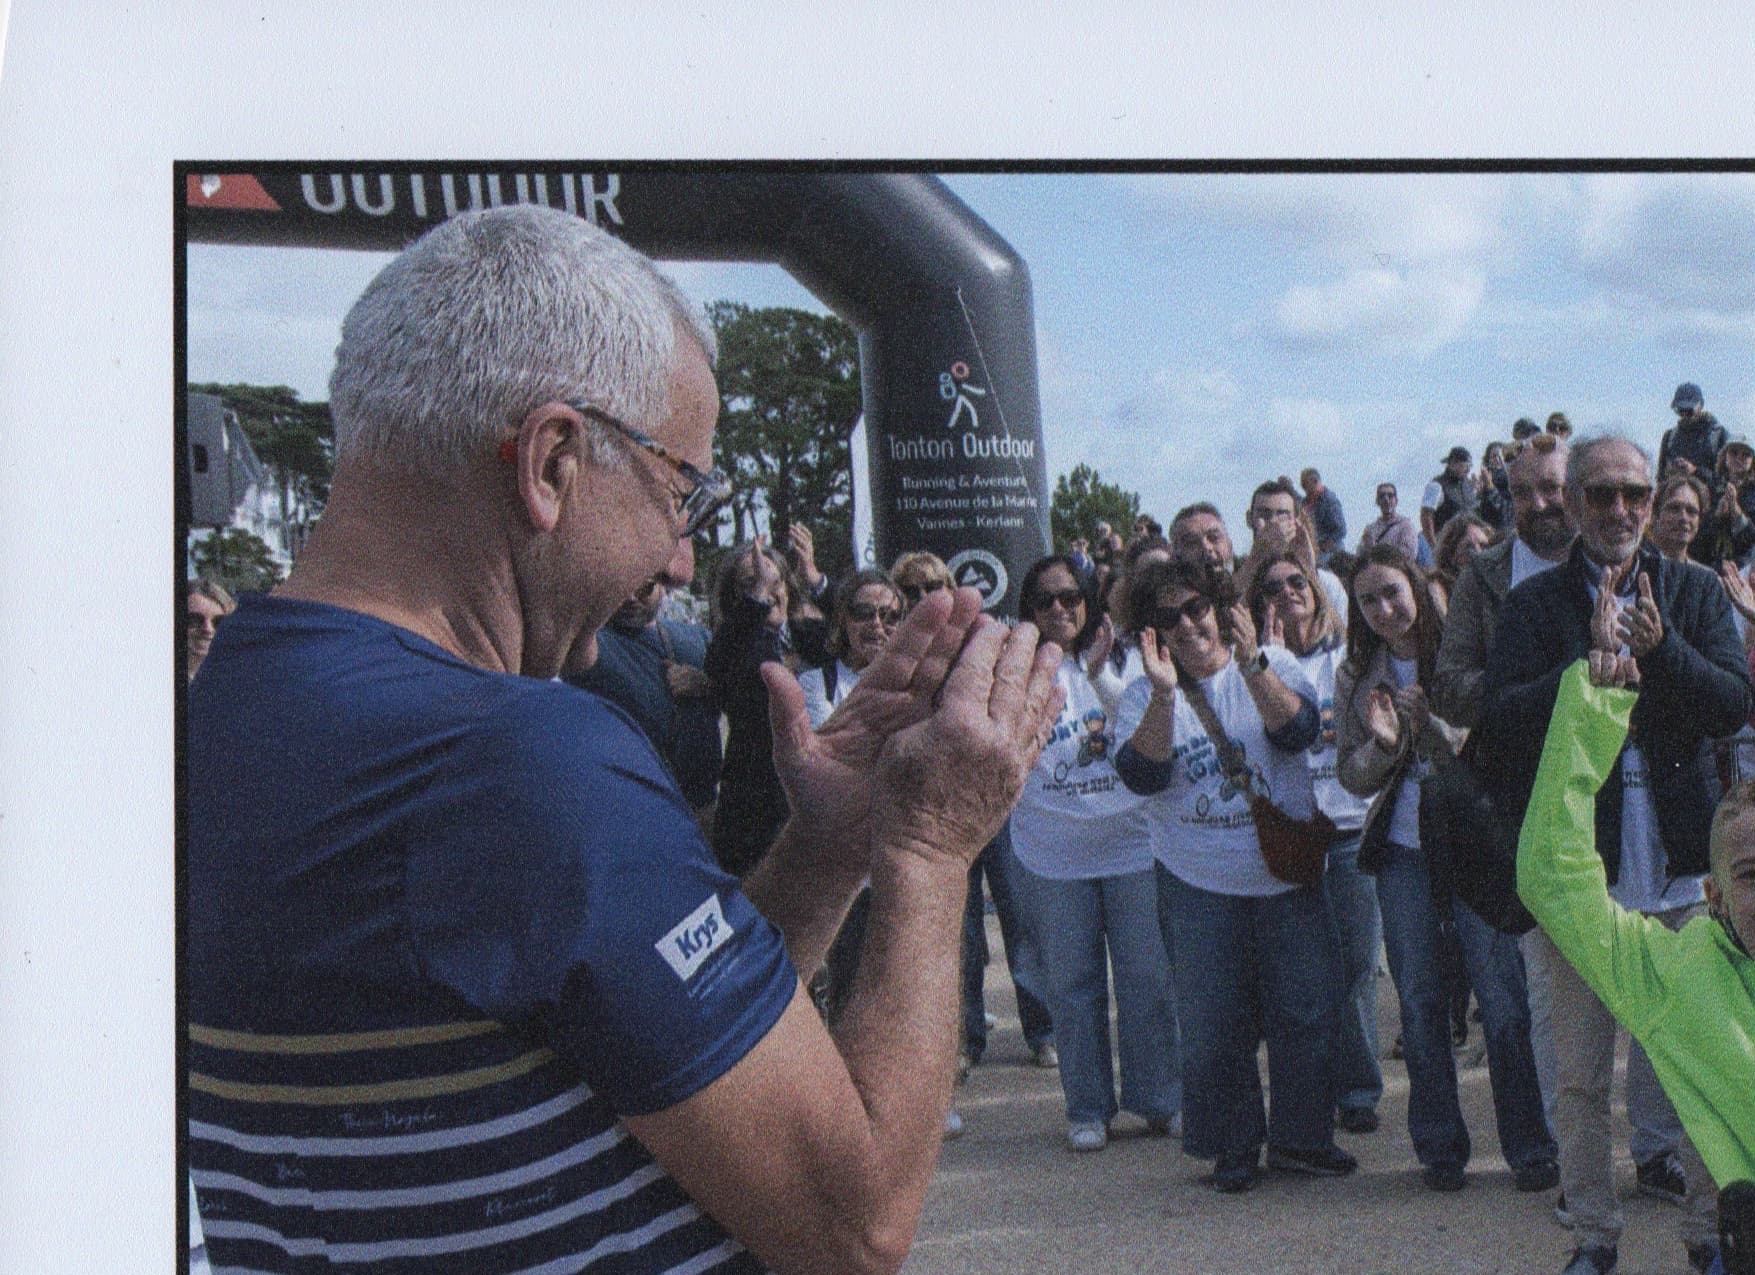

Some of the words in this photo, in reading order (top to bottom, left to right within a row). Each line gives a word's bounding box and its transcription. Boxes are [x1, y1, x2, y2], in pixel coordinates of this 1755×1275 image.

[888, 435, 954, 459] Tonton
[962, 432, 1035, 458] Outdoor
[902, 475, 956, 490] Running
[919, 497, 970, 510] Avenue
[973, 495, 989, 509] de
[916, 517, 965, 530] Vannes
[674, 912, 720, 960] Krys
